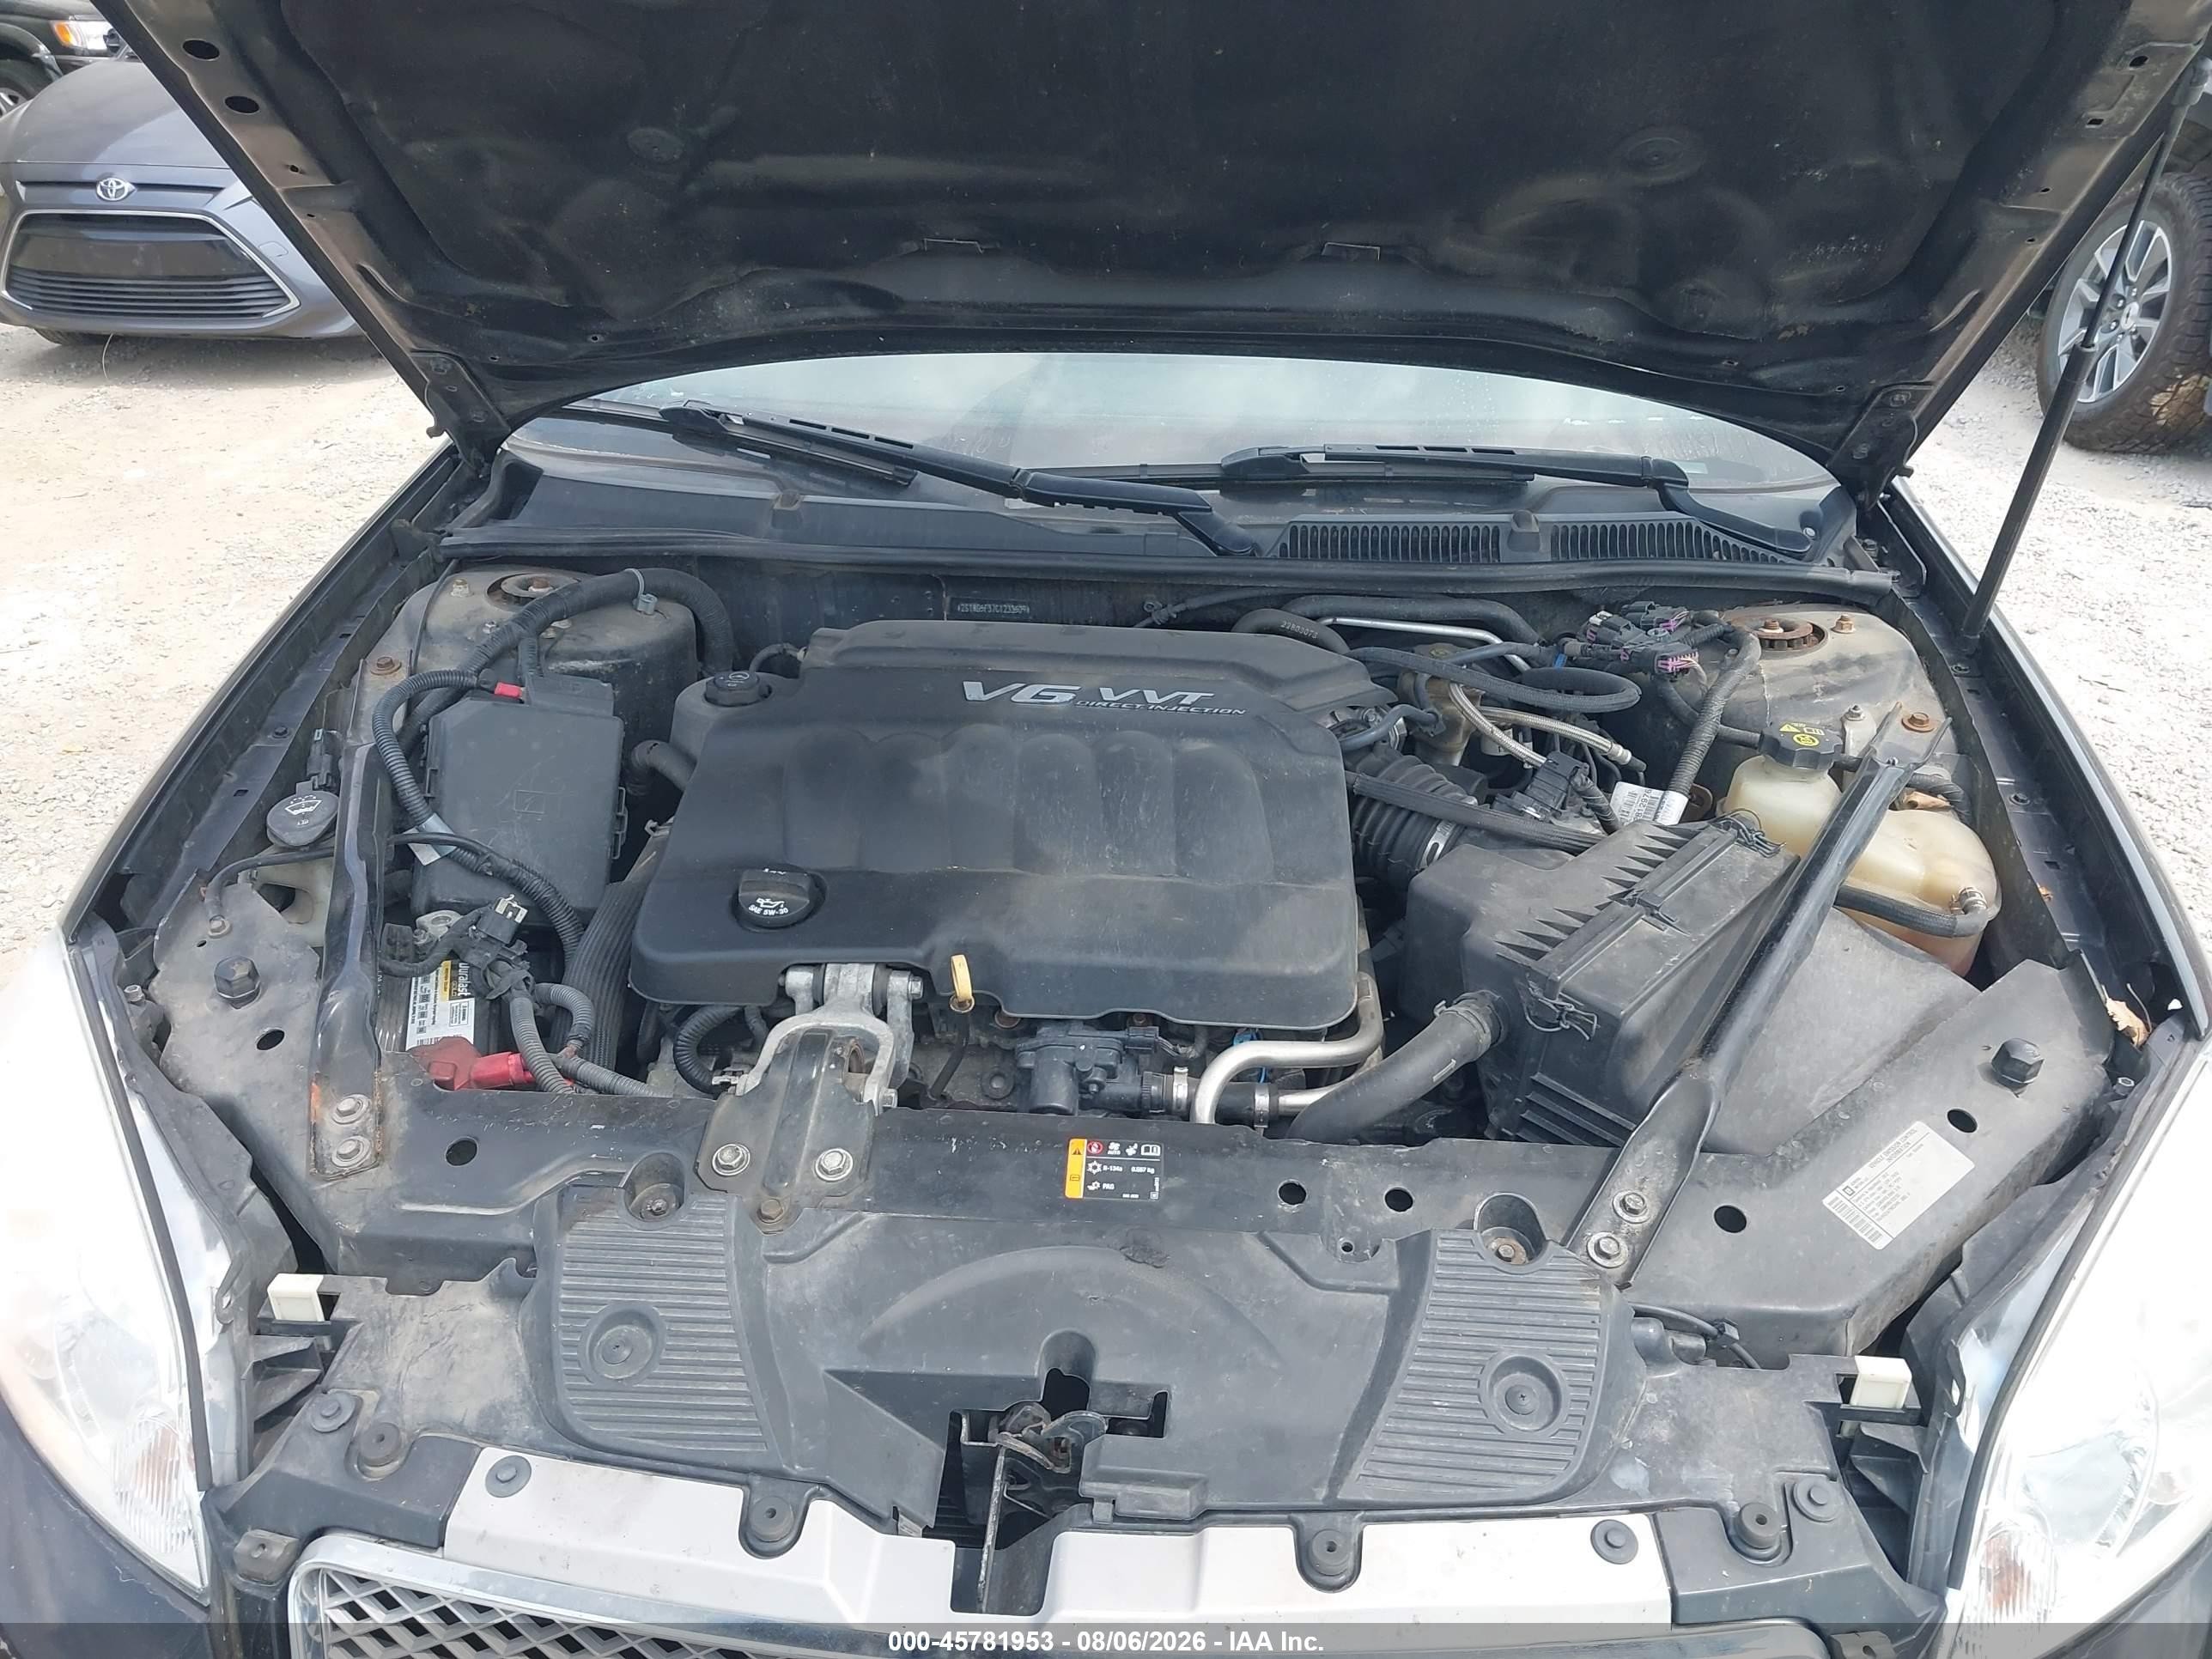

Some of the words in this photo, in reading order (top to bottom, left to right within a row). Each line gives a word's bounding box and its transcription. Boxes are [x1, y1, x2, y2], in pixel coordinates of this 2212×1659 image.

[963, 681, 1081, 702] V6
[1100, 687, 1215, 705] VVT
[1077, 701, 1143, 709] DIRECT
[1147, 705, 1246, 714] INJECTION
[749, 904, 763, 915] SAE
